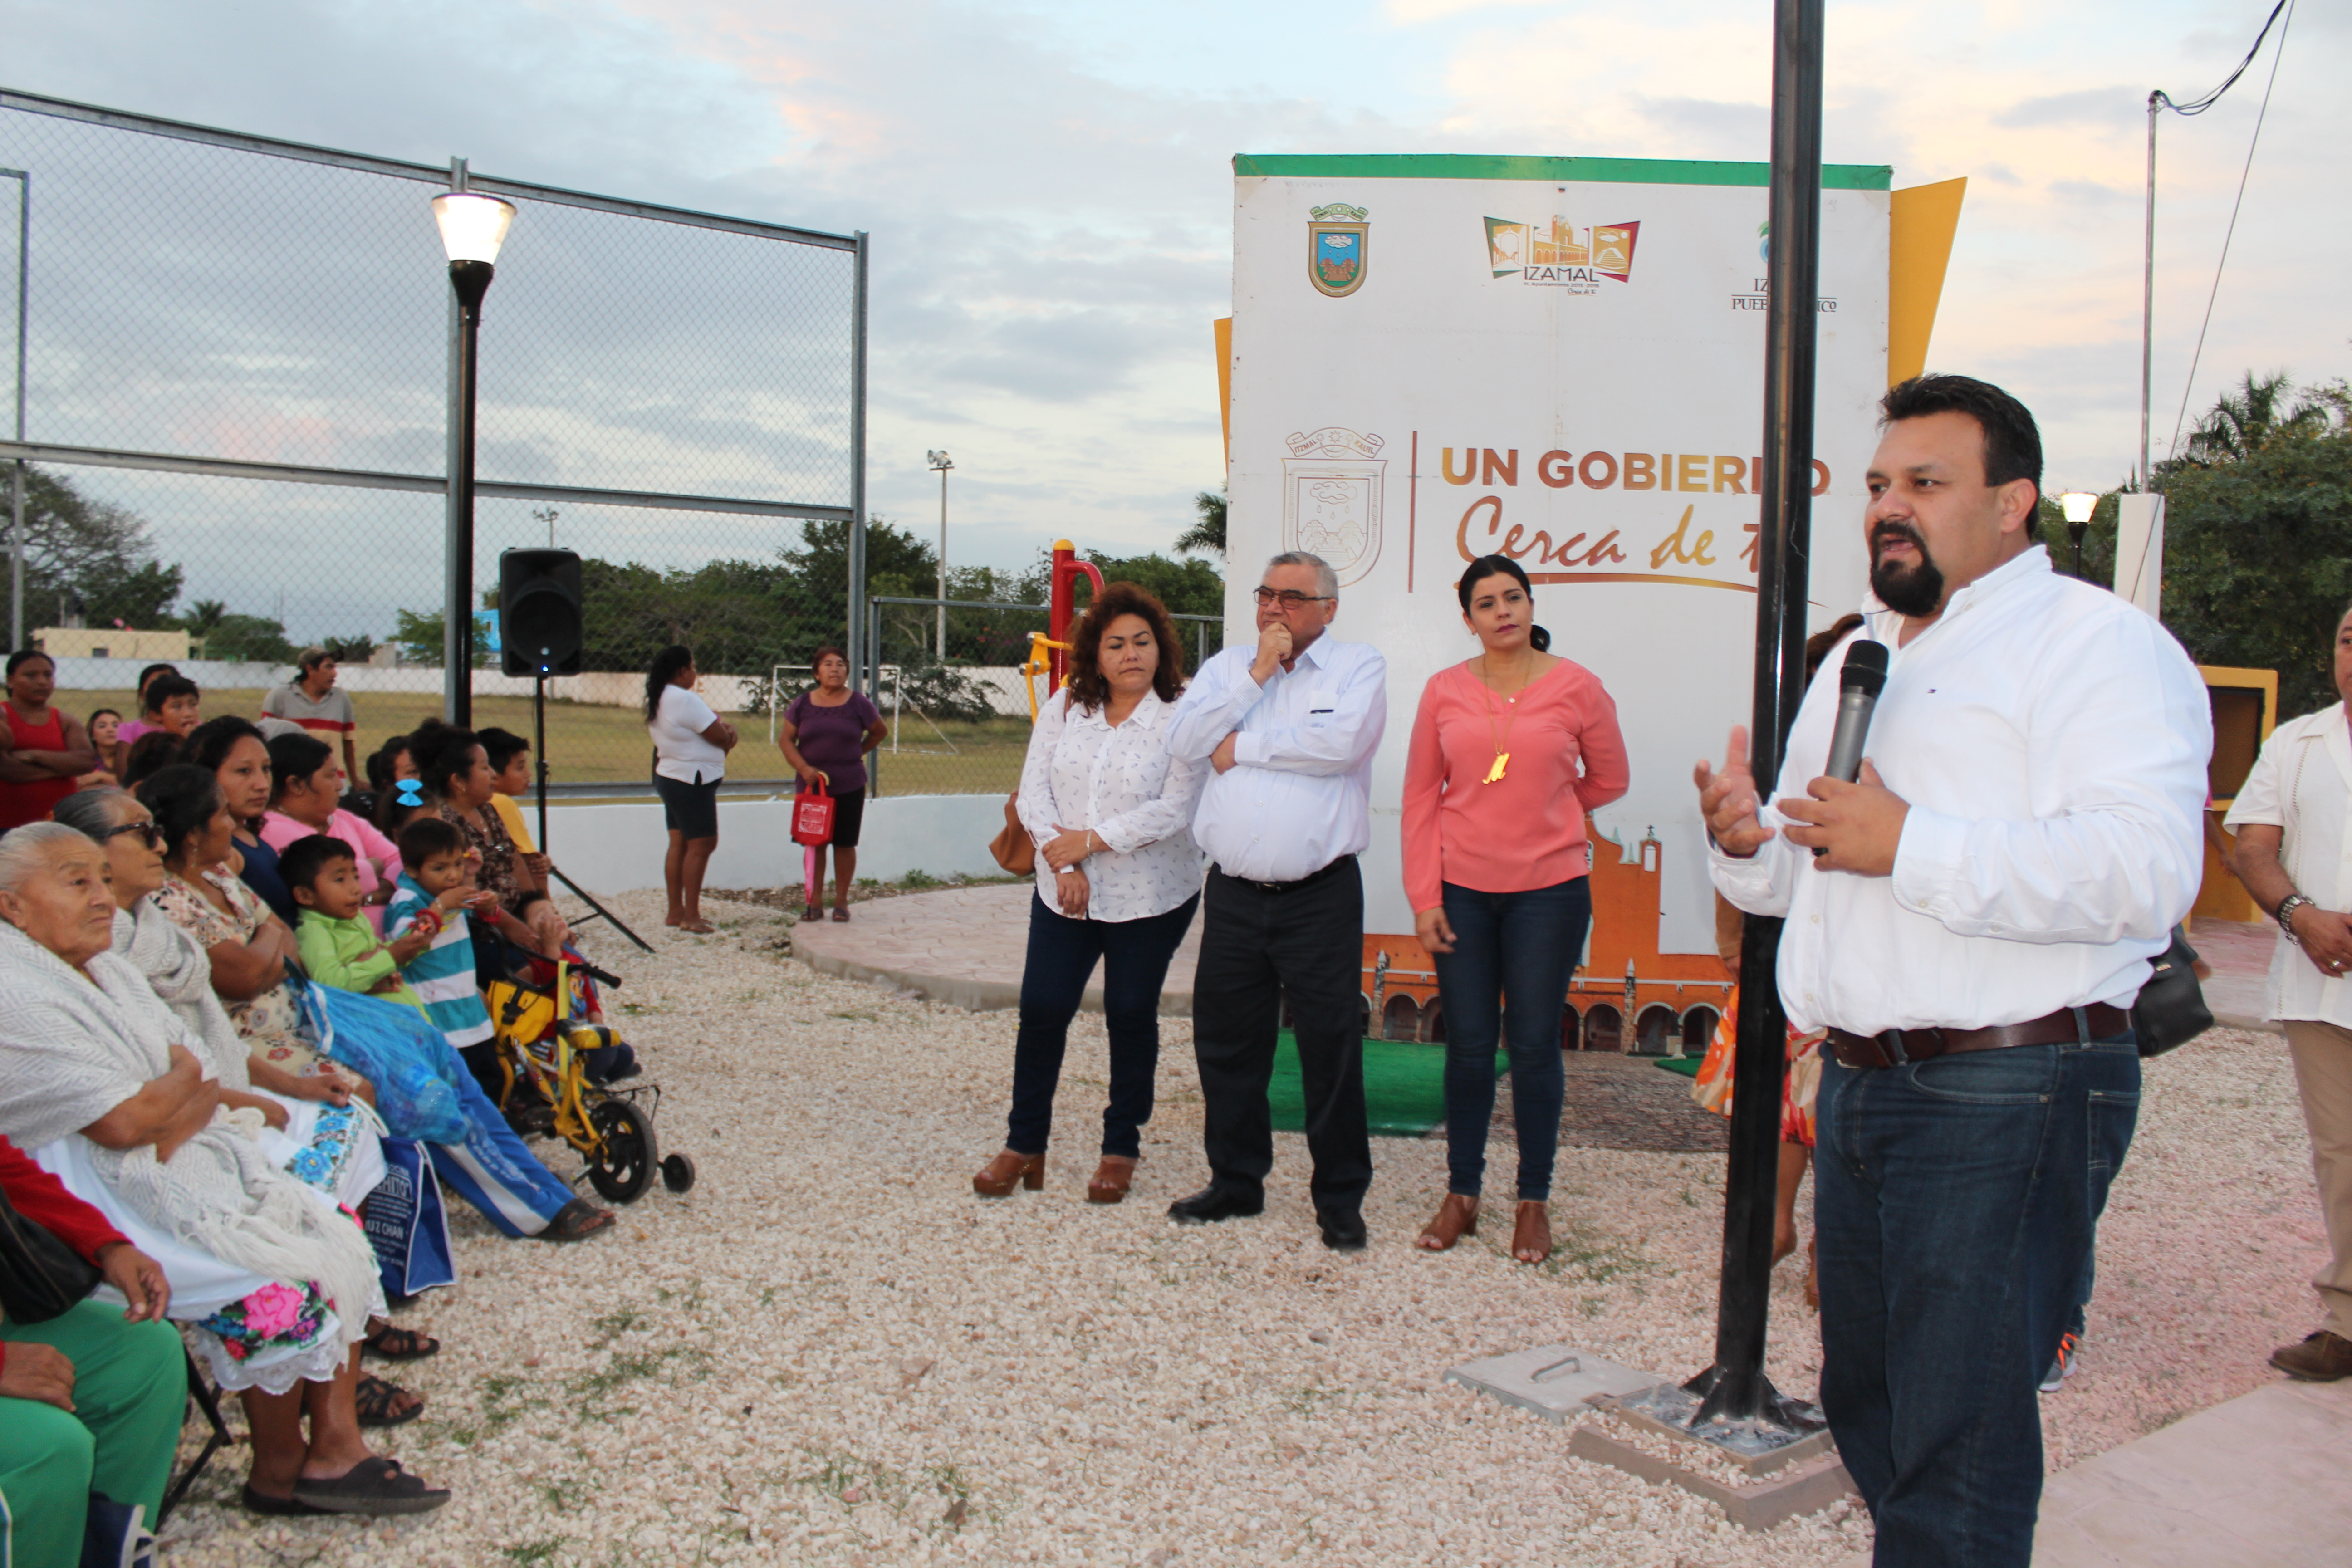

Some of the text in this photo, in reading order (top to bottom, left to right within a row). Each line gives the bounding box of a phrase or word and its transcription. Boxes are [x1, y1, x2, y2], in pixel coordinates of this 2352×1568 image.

[1525, 266, 1600, 282] IZAMAL
[1731, 299, 1768, 310] PUEB
[1294, 439, 1375, 454] ITZMAL KAUIL
[1442, 447, 1518, 486] UN
[1457, 496, 1627, 567] Cerca
[1650, 504, 1716, 570] de
